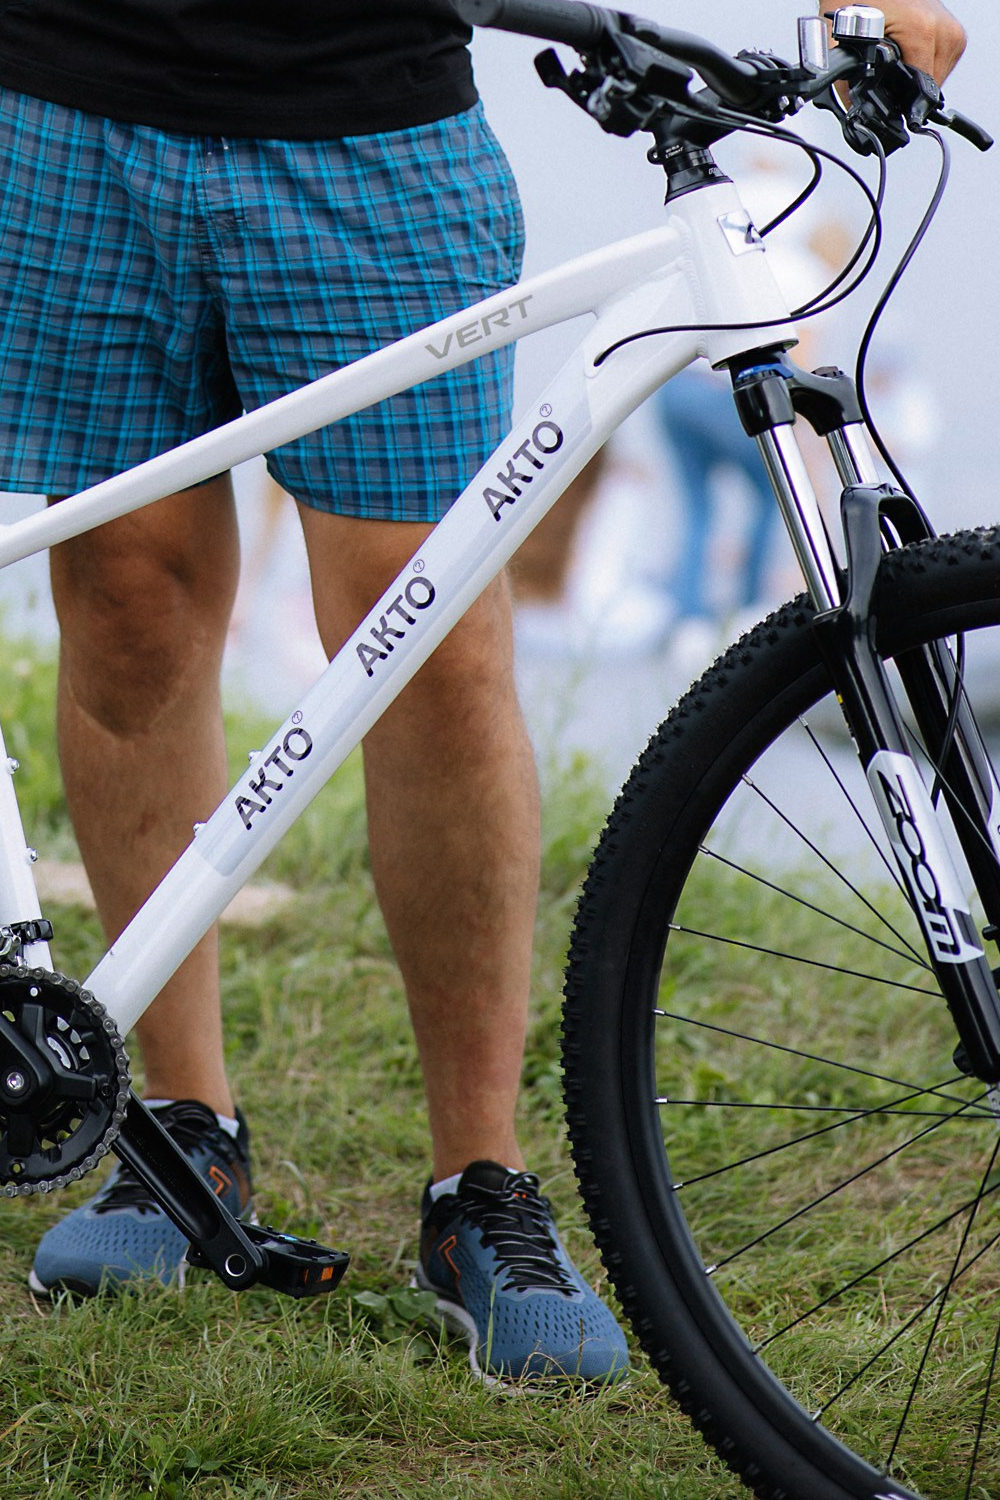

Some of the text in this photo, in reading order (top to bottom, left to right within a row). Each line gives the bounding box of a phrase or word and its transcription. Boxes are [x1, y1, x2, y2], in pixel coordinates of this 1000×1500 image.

[424, 294, 533, 360] VERT
[482, 420, 564, 522] АКТО
[356, 576, 436, 678] АКТО
[234, 727, 313, 831] АКТО
